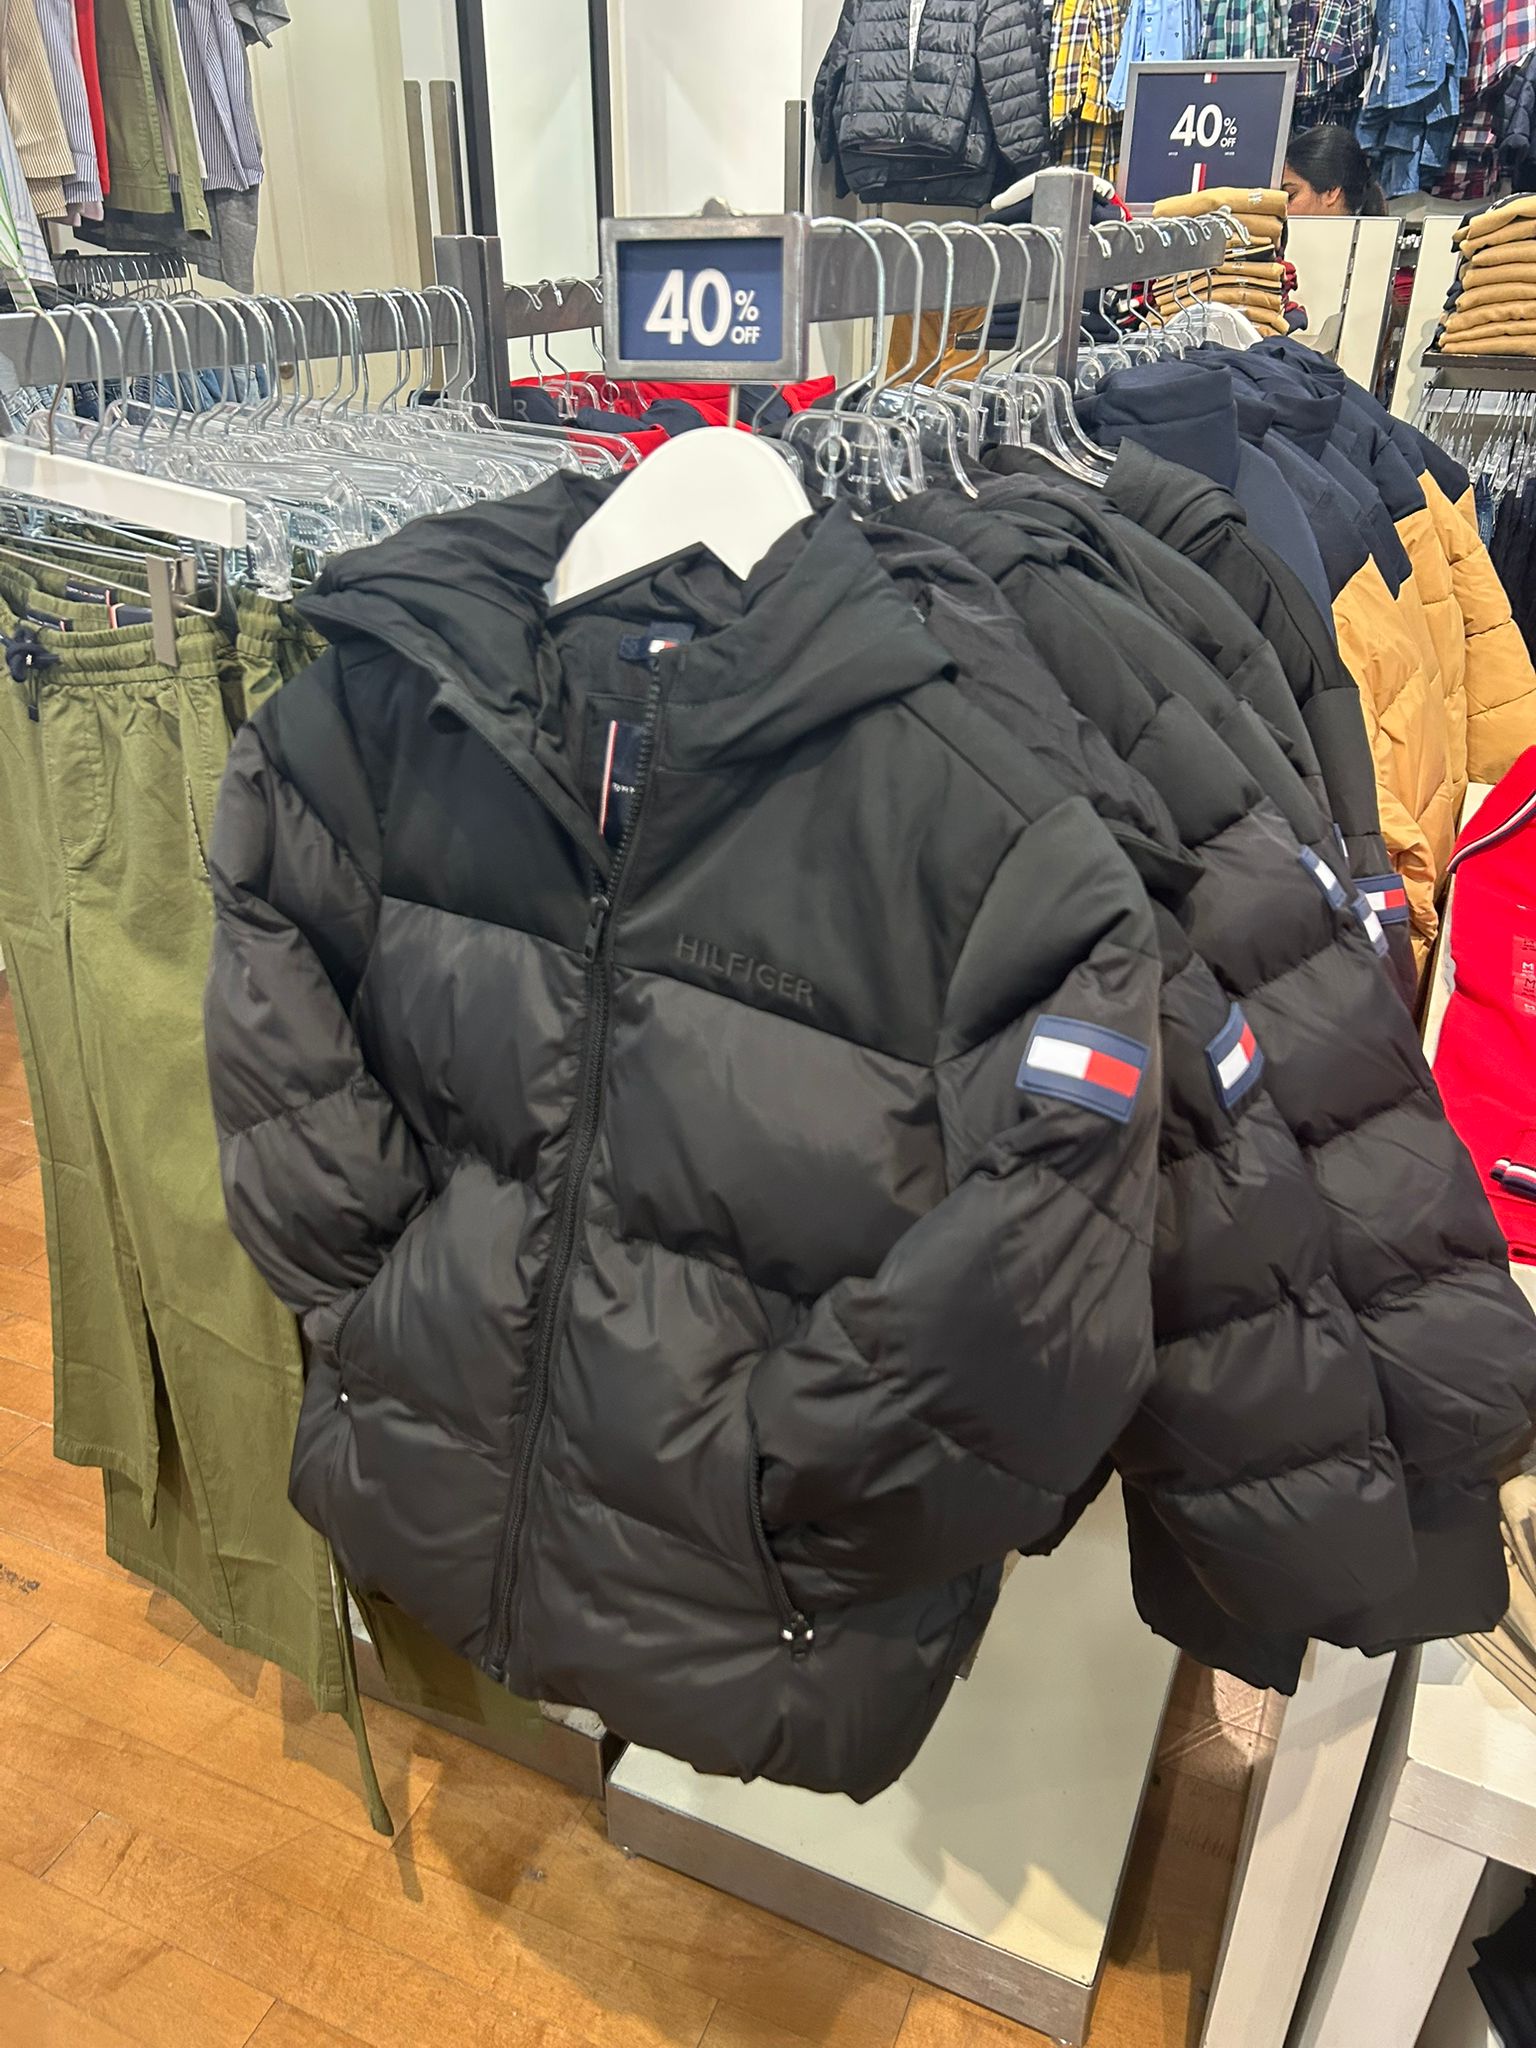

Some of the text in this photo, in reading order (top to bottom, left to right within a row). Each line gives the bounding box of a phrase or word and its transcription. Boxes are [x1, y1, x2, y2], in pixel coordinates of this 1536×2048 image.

[1220, 137, 1237, 148] OFF
[730, 326, 761, 345] OFF
[676, 933, 814, 1008] HILFIGER
